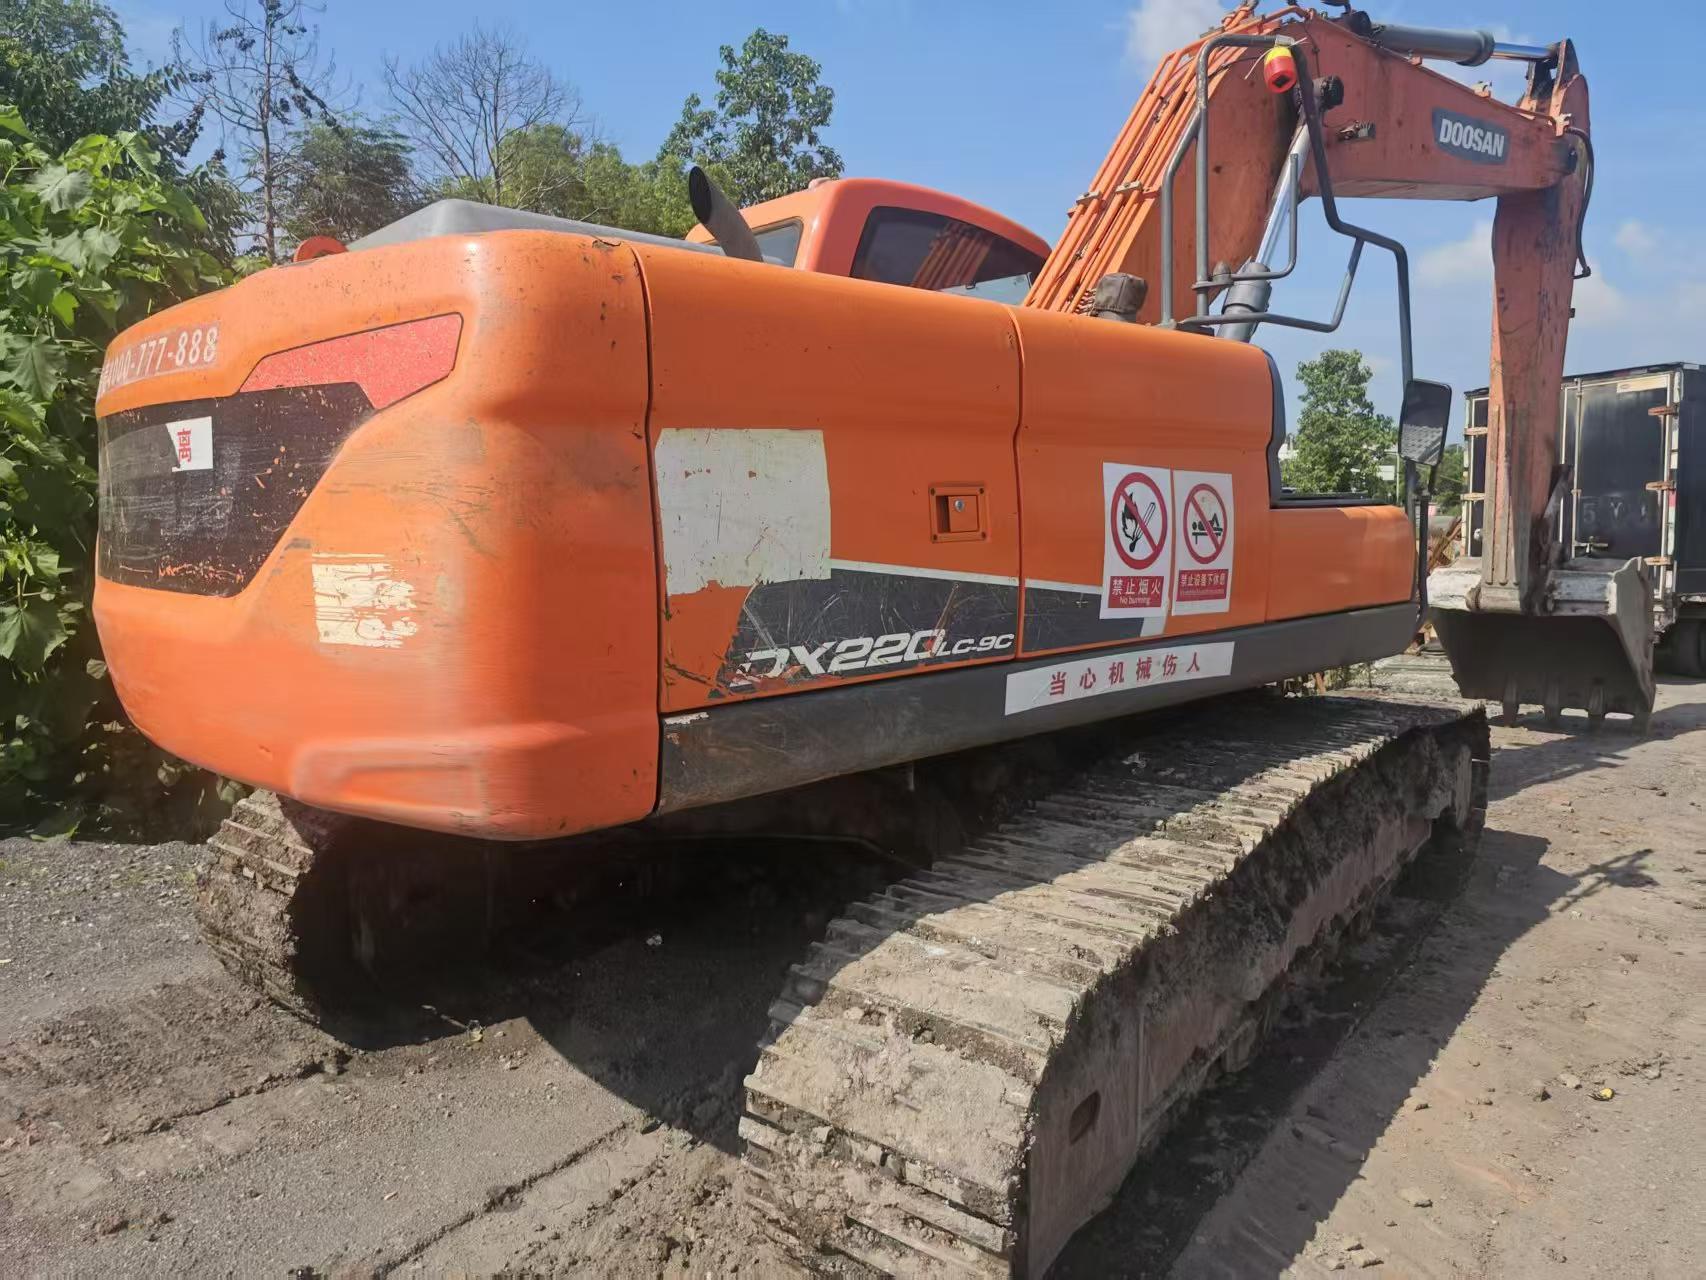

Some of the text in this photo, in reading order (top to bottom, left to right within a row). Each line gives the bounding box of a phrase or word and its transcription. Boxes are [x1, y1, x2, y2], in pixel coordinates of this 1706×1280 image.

[1440, 118, 1505, 157] DOOSAN
[1111, 578, 1161, 596] 禁止烟火
[1049, 651, 1201, 697] 当心机械伤人
